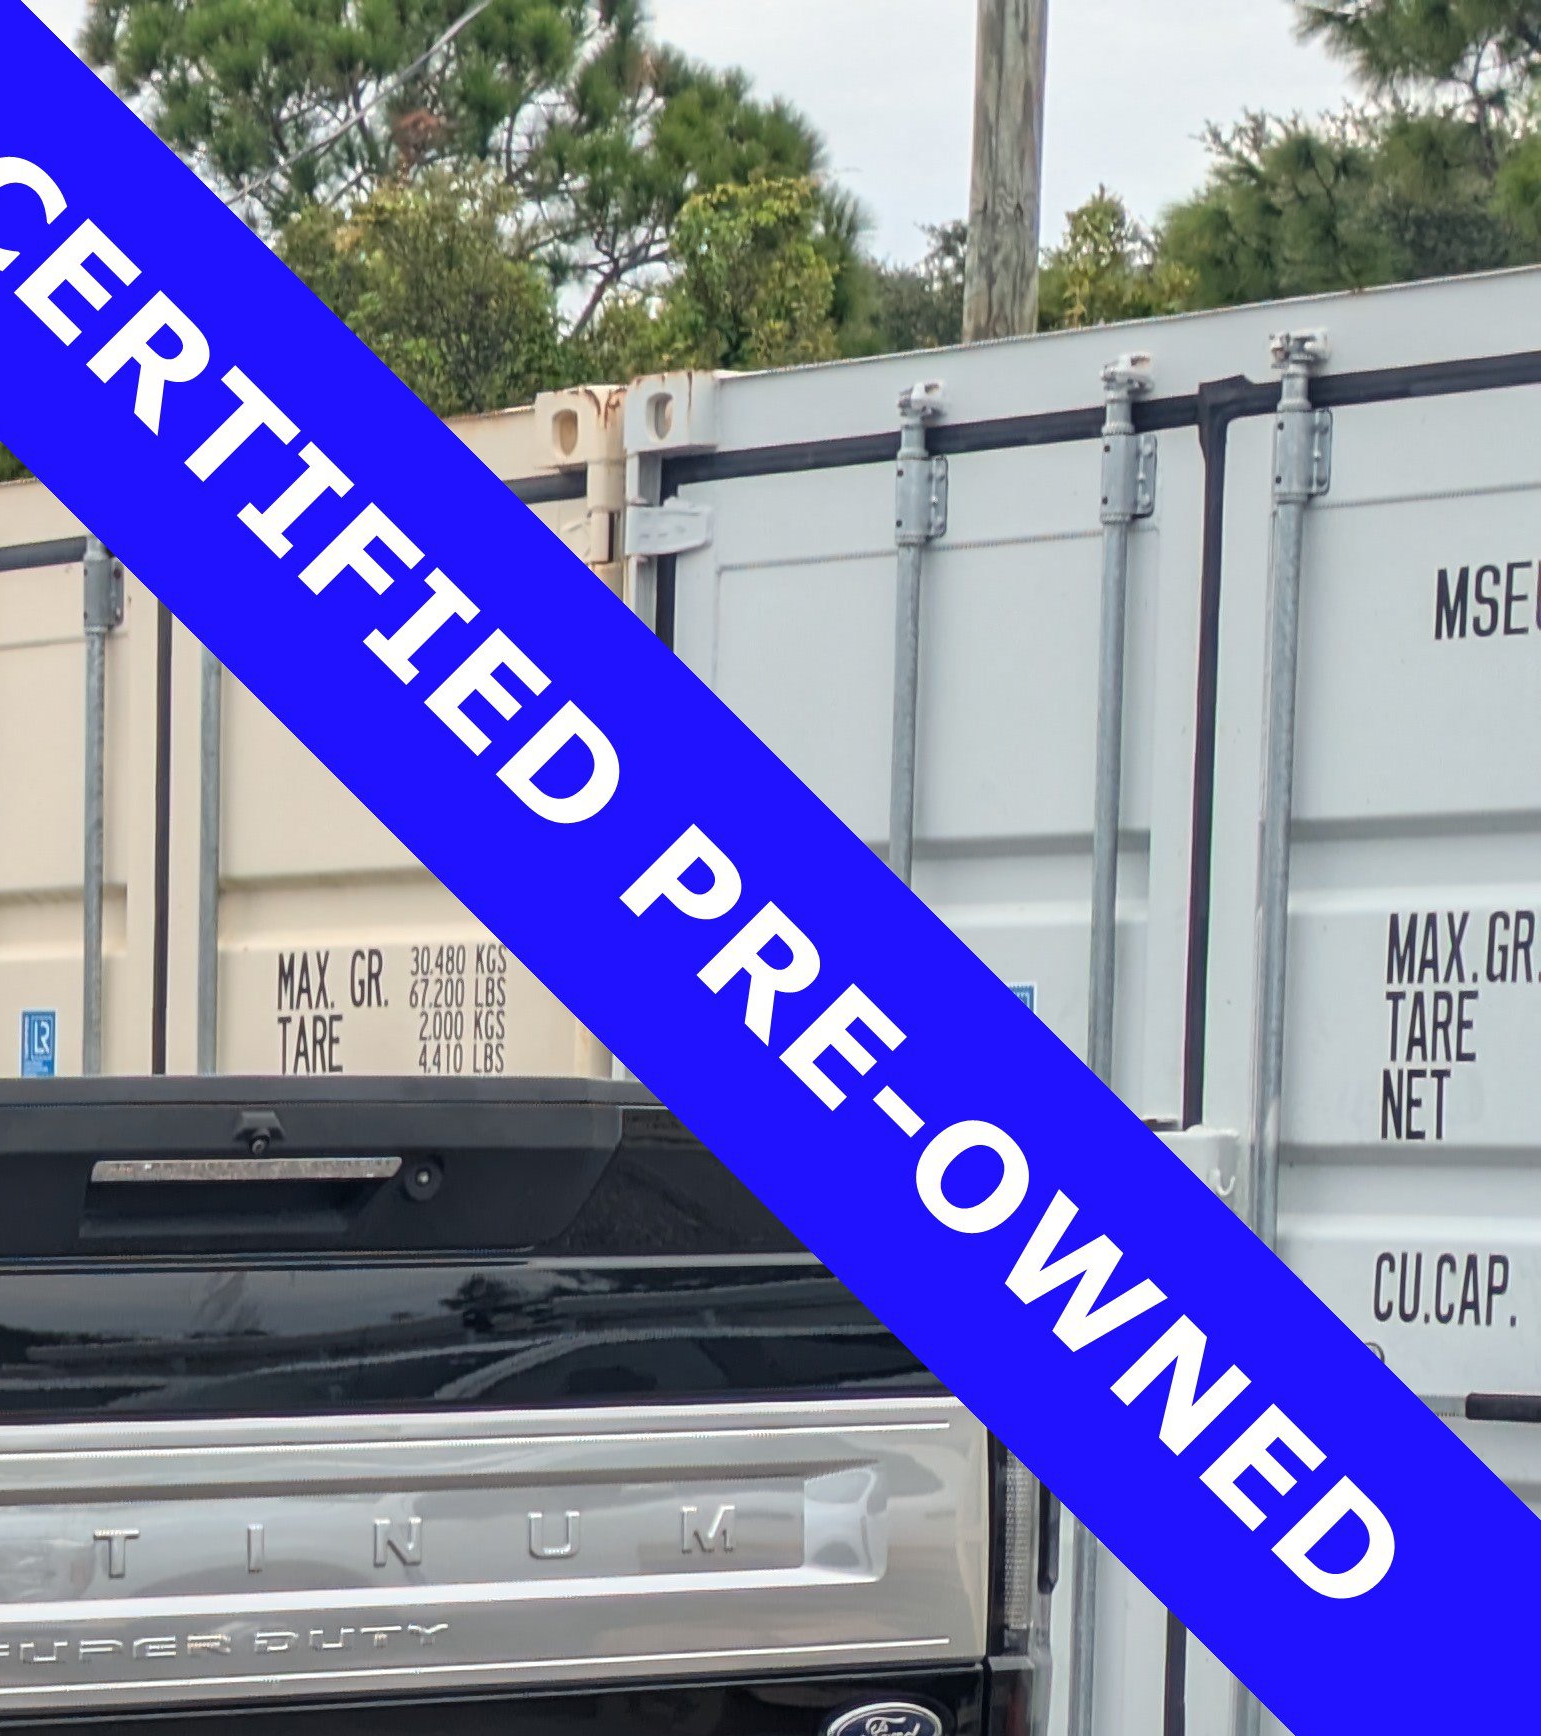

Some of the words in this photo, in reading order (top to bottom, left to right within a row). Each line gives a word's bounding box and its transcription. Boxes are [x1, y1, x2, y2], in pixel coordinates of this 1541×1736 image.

[1434, 559, 1541, 640] MSE
[277, 950, 335, 1010] MAX.
[350, 948, 389, 1008] GR.
[410, 944, 466, 976] 30.480
[475, 943, 507, 975] KGS
[409, 978, 465, 1008] 67.200
[474, 976, 506, 1008] LBS
[277, 1014, 343, 1075] TARE
[418, 1010, 464, 1041] 2.000
[473, 1009, 505, 1040] KGS
[1385, 990, 1479, 1062] TARE
[418, 1043, 463, 1074] 4.410
[472, 1042, 505, 1074] LBS
[1380, 1068, 1451, 1140] NET
[253, 1622, 448, 1653] DUTY
